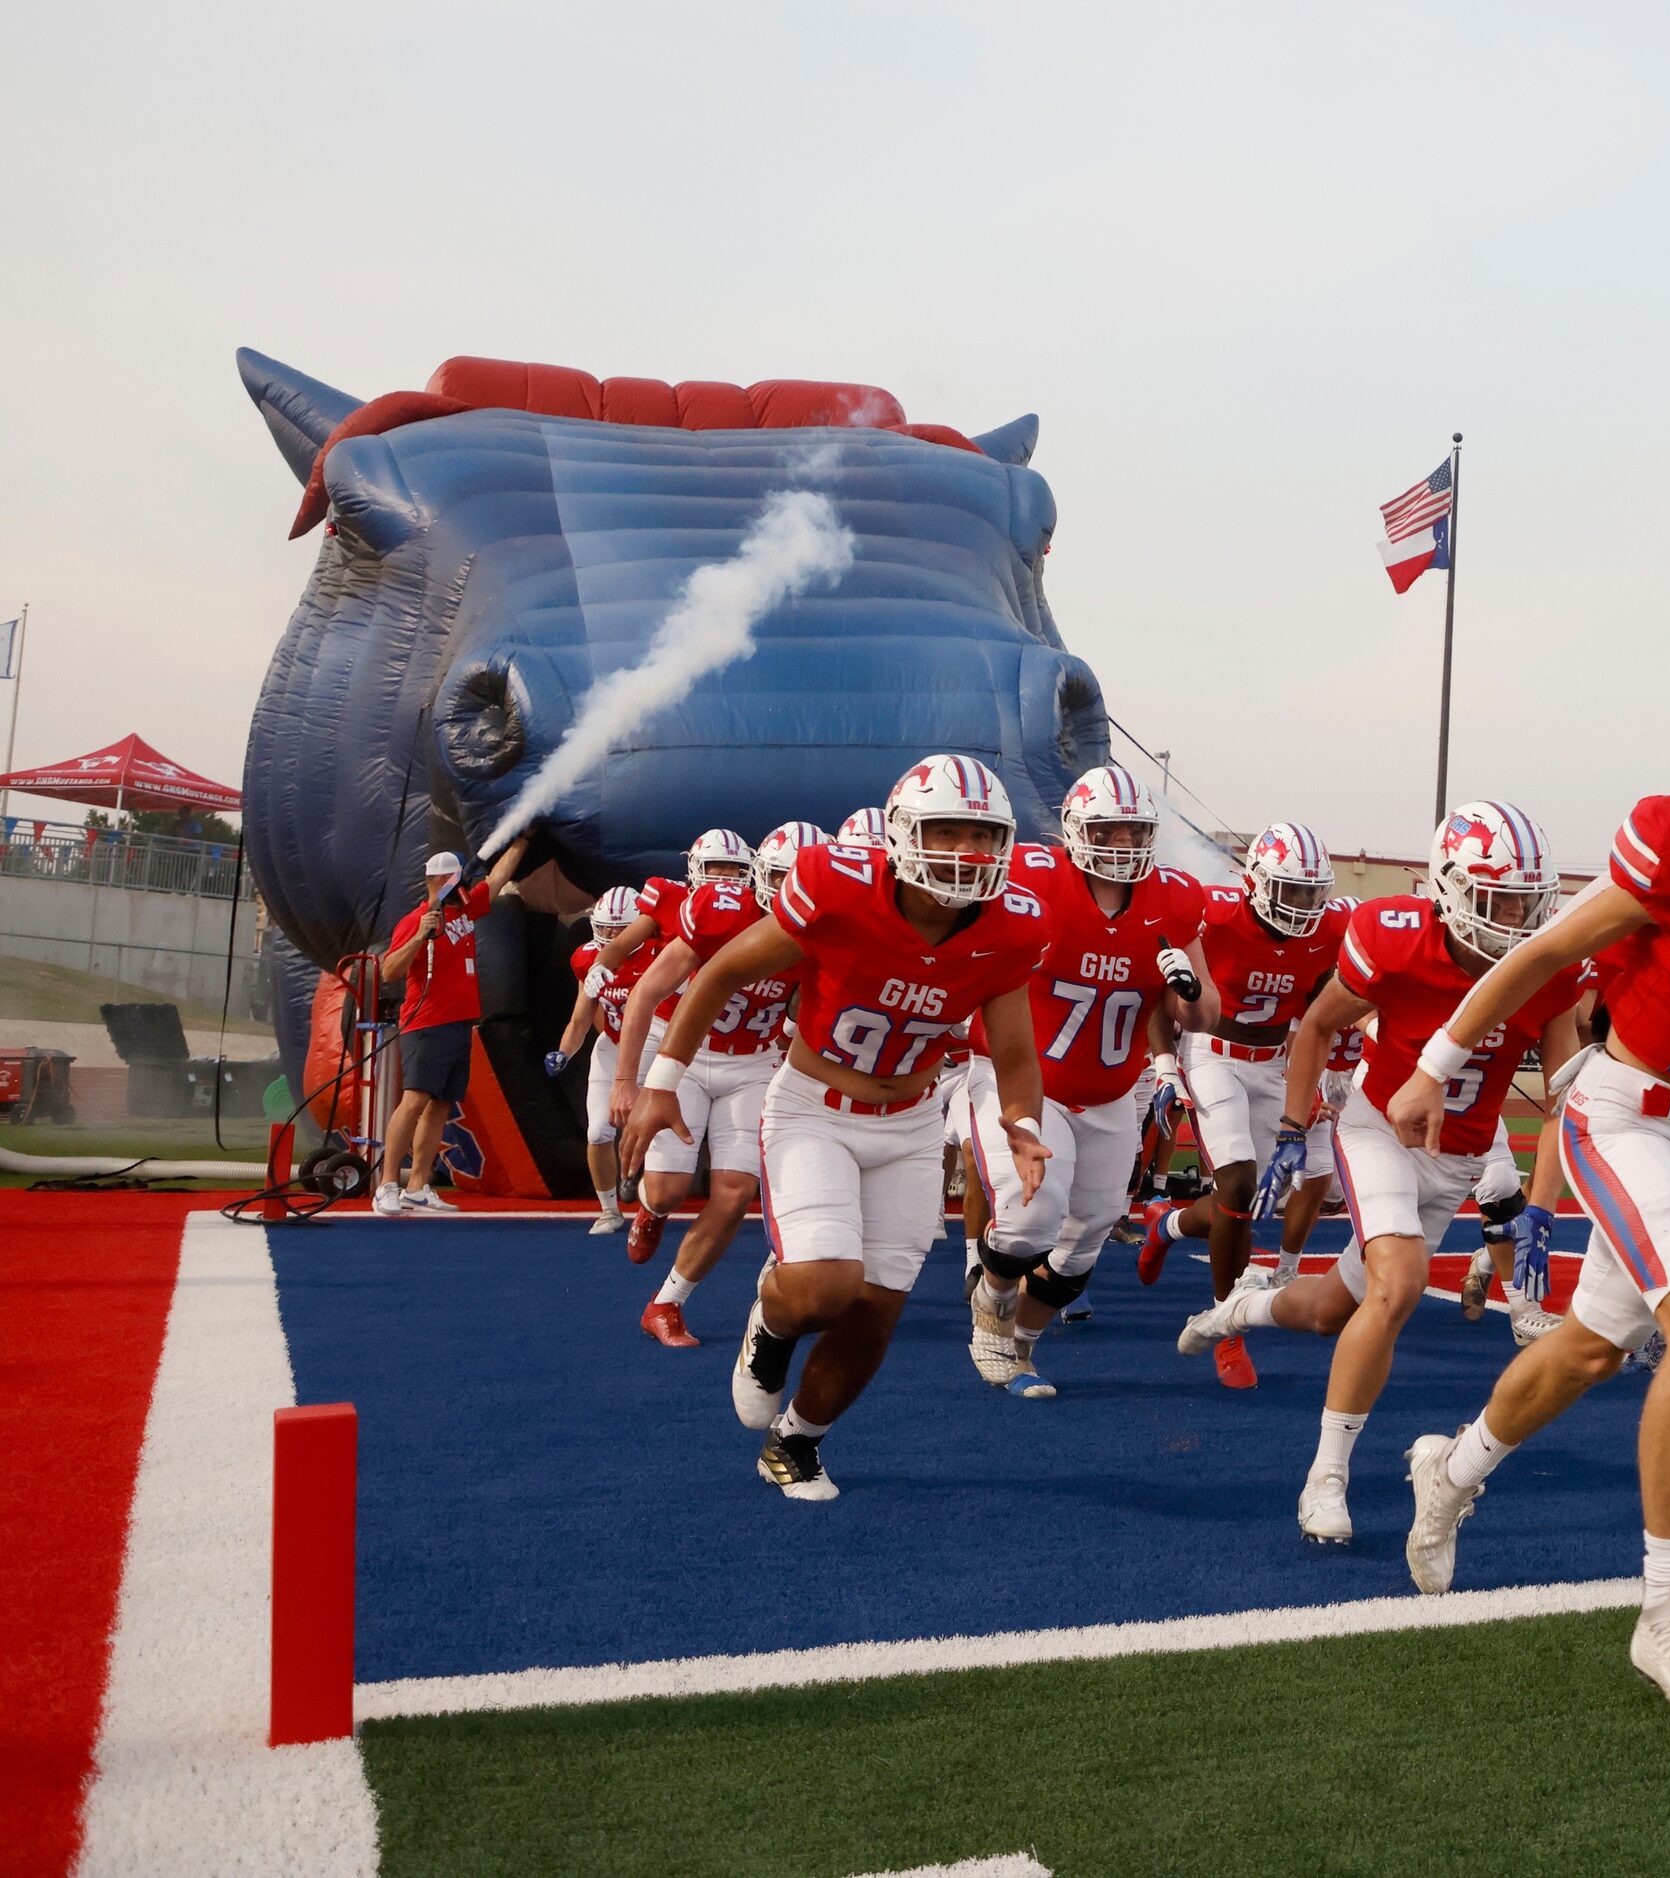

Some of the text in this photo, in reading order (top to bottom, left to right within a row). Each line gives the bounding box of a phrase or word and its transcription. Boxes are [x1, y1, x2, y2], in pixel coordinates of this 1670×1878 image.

[966, 800, 989, 811] 104
[1120, 807, 1138, 815] 104
[827, 844, 873, 886] 97
[1304, 869, 1319, 878] 104
[1523, 872, 1542, 882] 104
[712, 883, 742, 911] 34
[1212, 890, 1241, 904] 2
[1379, 909, 1421, 929] 5
[1080, 952, 1132, 982] GHS
[1248, 971, 1295, 994] GHS
[878, 978, 948, 1017] GHS
[1234, 995, 1281, 1026] 2
[711, 992, 787, 1040] 34
[1044, 980, 1144, 1068] 70
[821, 1006, 954, 1077] 97
